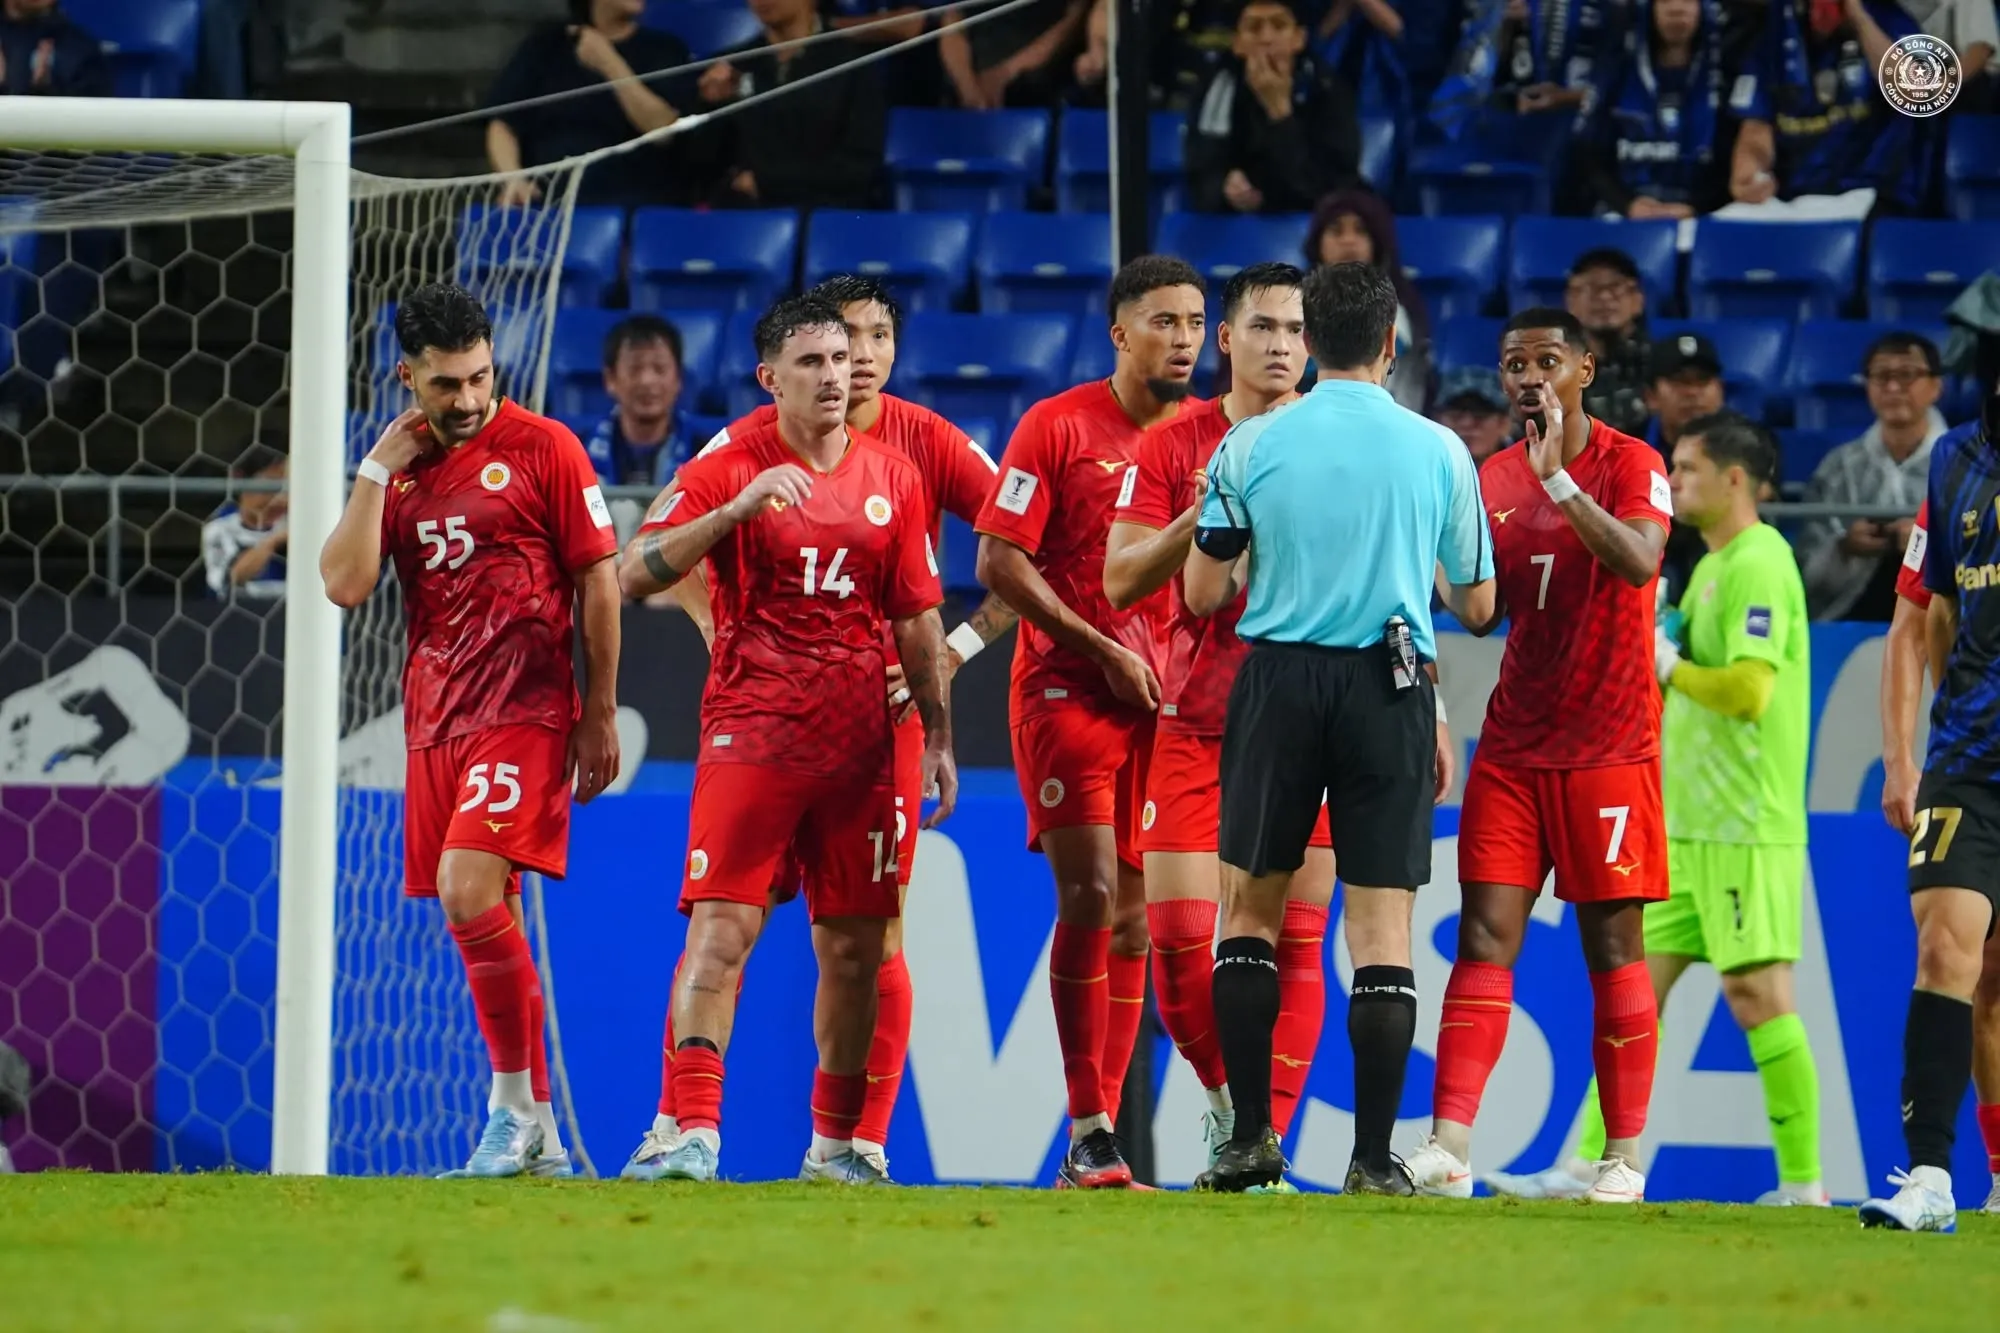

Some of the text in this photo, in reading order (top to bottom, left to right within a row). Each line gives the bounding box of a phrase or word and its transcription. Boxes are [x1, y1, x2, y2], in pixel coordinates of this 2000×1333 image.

[416, 515, 475, 570] 55
[800, 546, 855, 599] 14
[1530, 553, 1555, 610] 7
[459, 762, 522, 813] 55
[1599, 805, 1630, 864] 7
[1908, 806, 1962, 869] 27
[1725, 887, 1742, 931] 1
